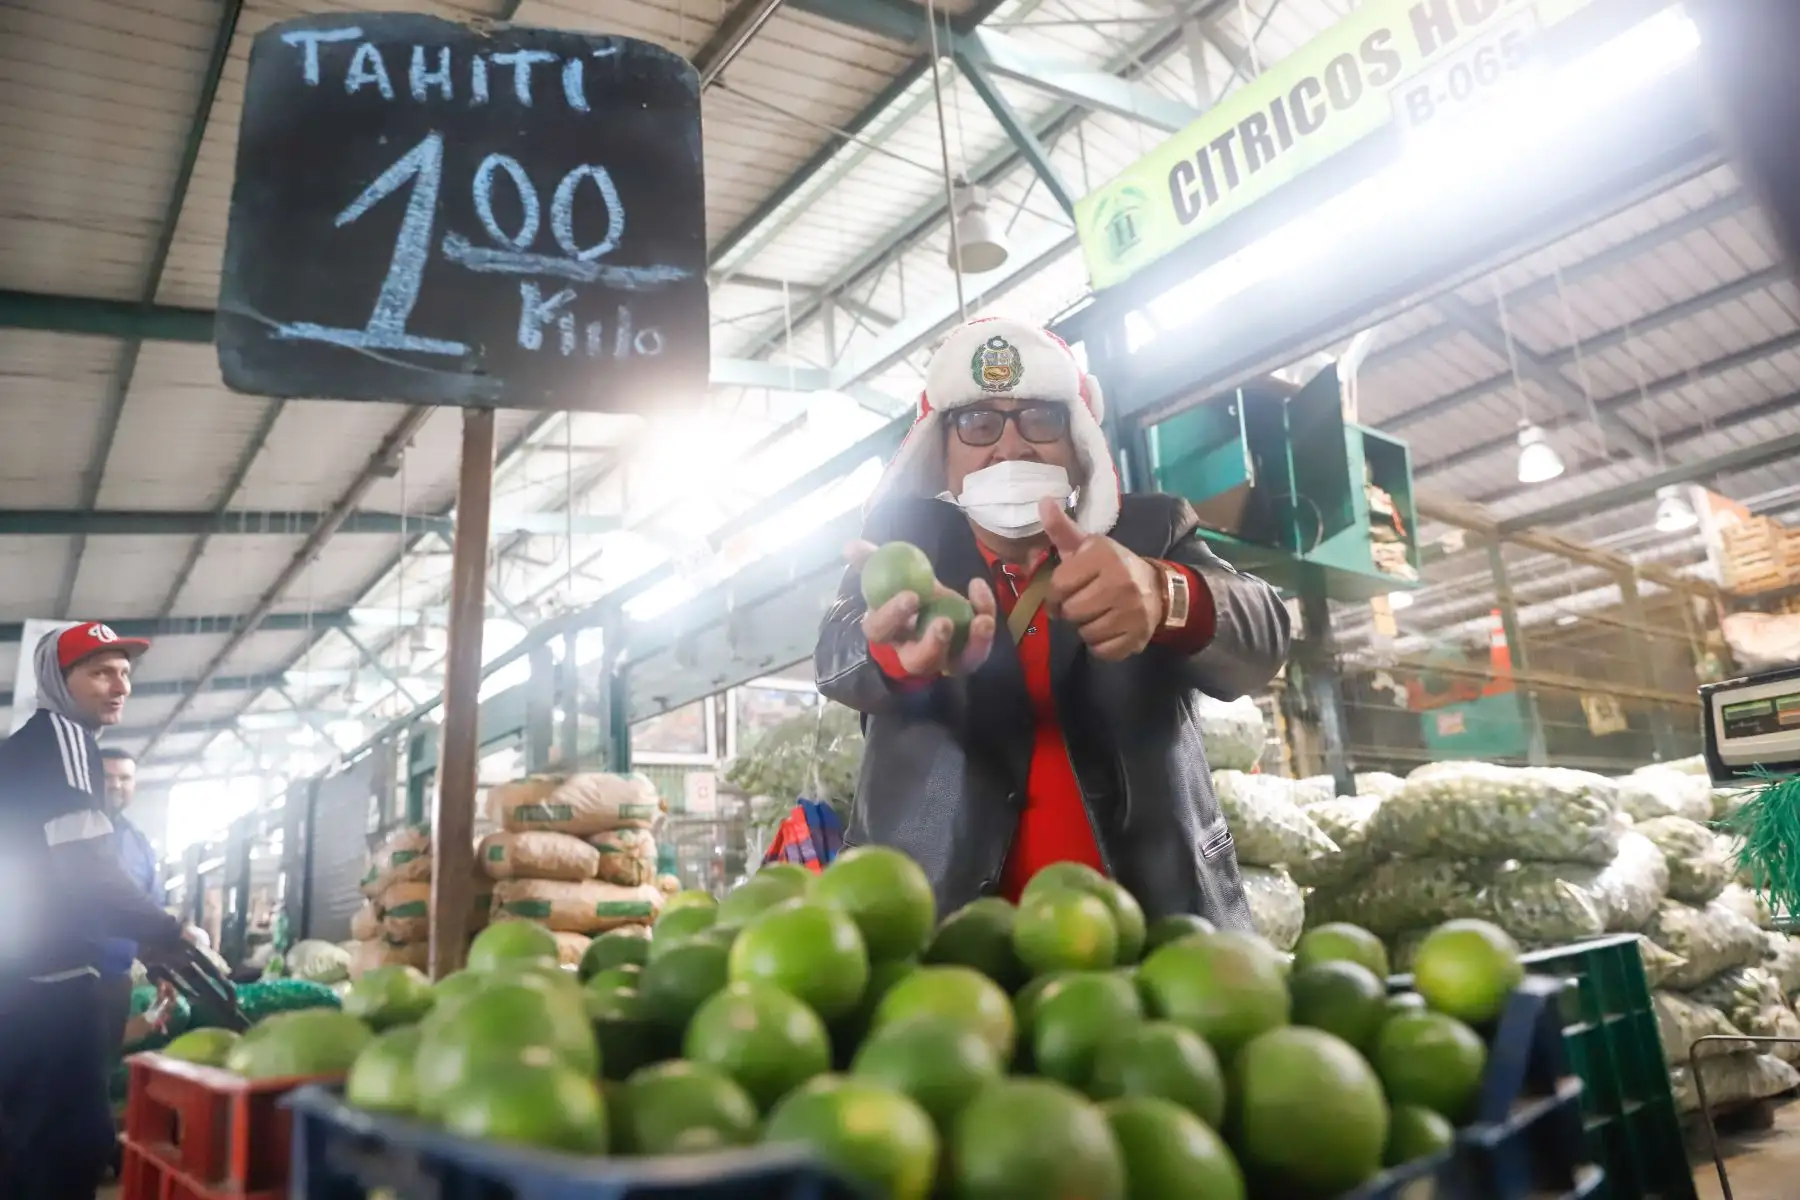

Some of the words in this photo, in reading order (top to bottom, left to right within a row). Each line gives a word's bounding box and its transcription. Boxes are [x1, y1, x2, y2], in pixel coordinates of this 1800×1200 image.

[1404, 28, 1528, 126] B-065
[1168, 28, 1402, 226] CITRICOS
[518, 281, 663, 357] Kilo
